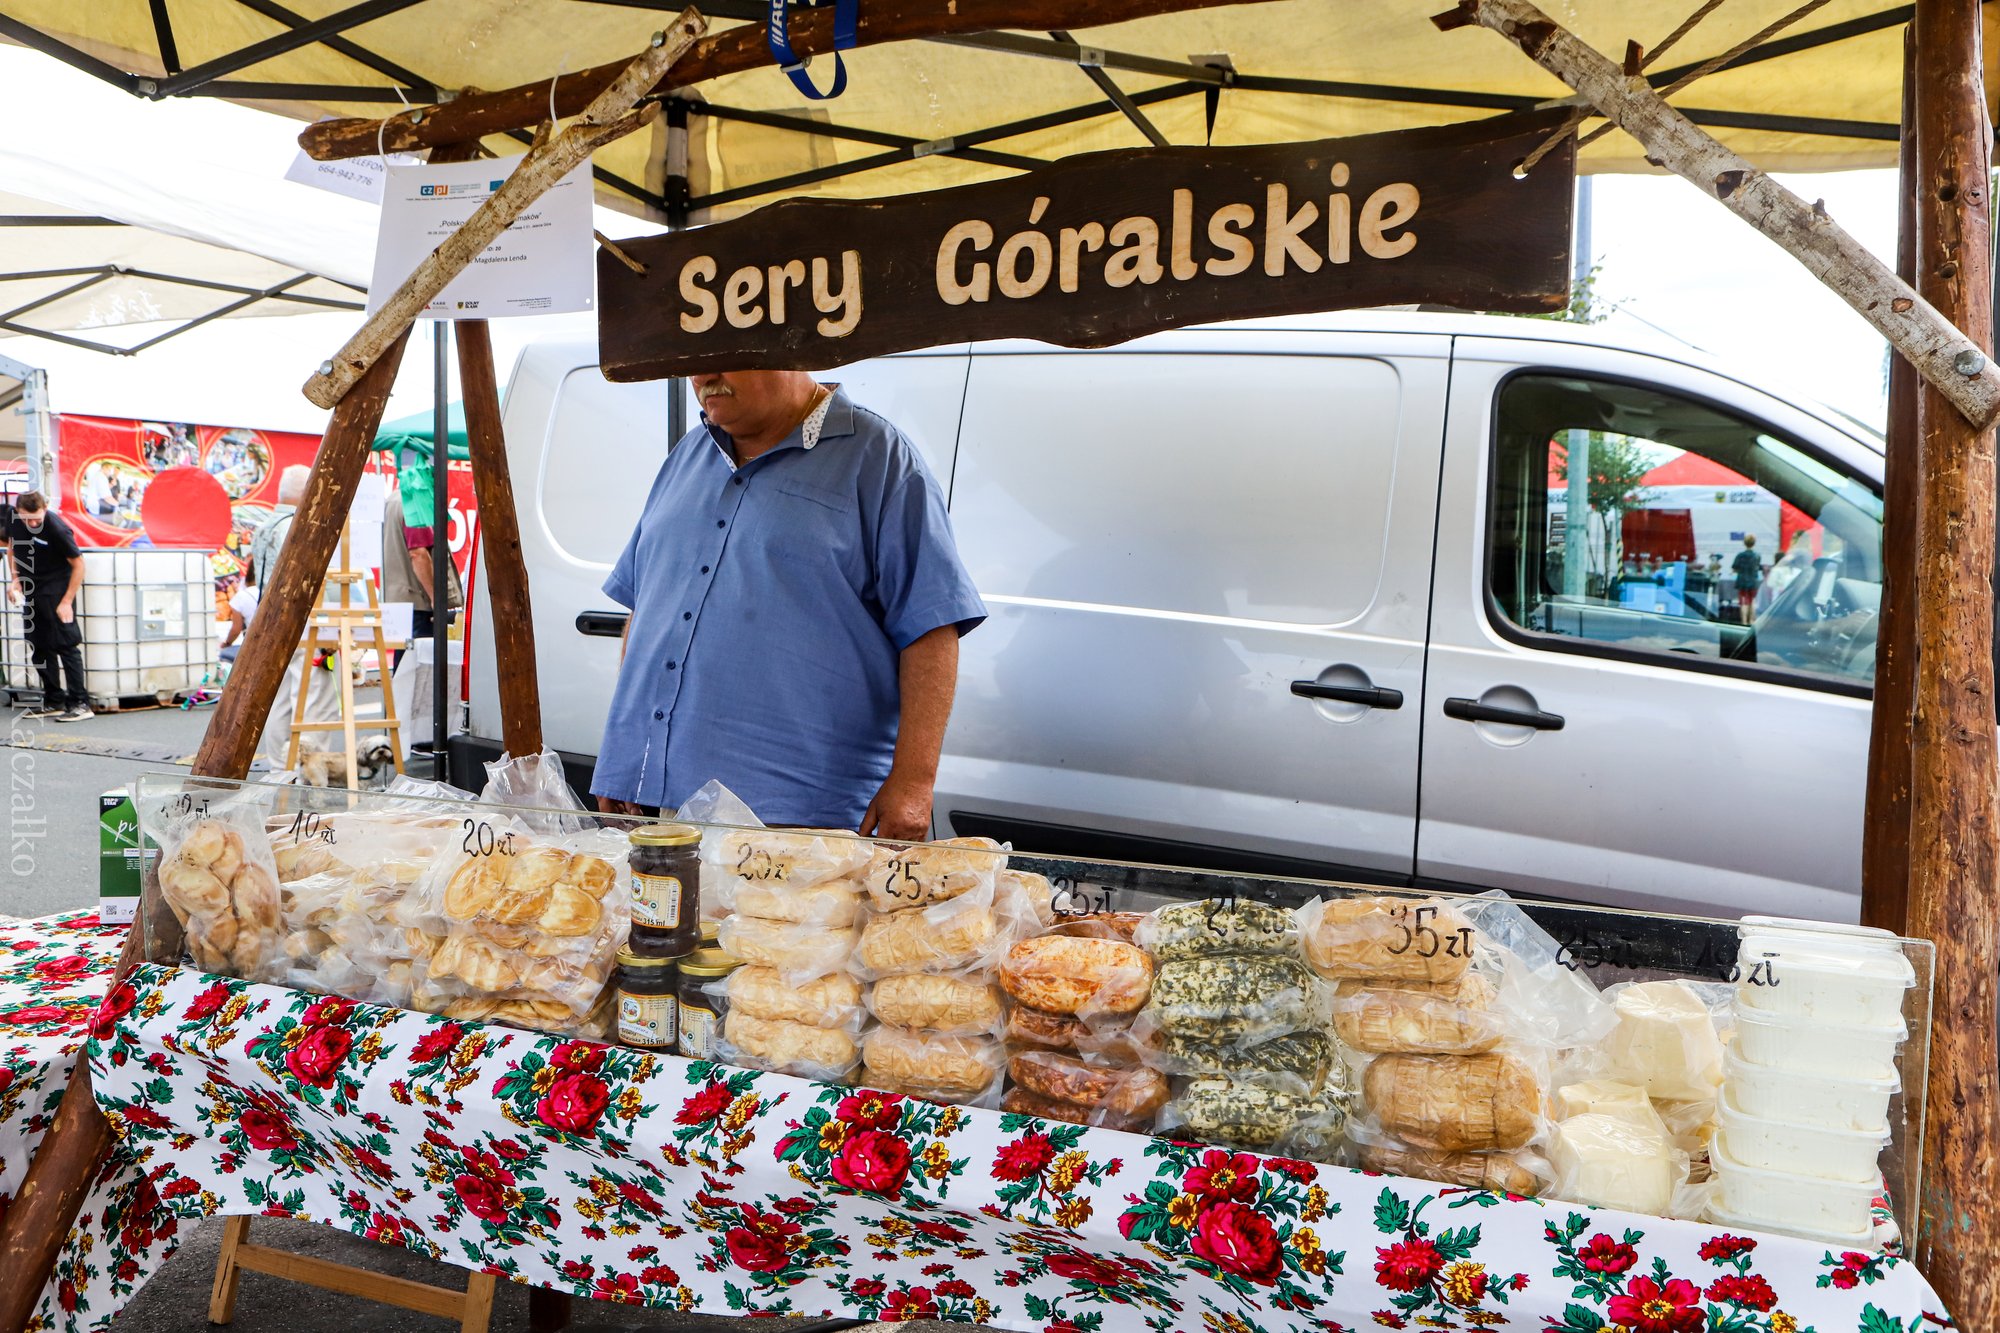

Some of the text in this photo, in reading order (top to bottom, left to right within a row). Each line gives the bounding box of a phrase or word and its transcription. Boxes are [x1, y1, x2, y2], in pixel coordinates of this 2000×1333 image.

[679, 162, 1421, 338] Sery Góralskie
[288, 809, 338, 845] 10 zł
[463, 818, 516, 857] 20 zł
[885, 860, 922, 900] 25
[1051, 876, 1118, 917] 25 zł
[1387, 904, 1476, 958] 35 zł
[1555, 924, 1602, 971] 25
[1747, 952, 1781, 987] zł
[641, 1038, 655, 1046] 315
